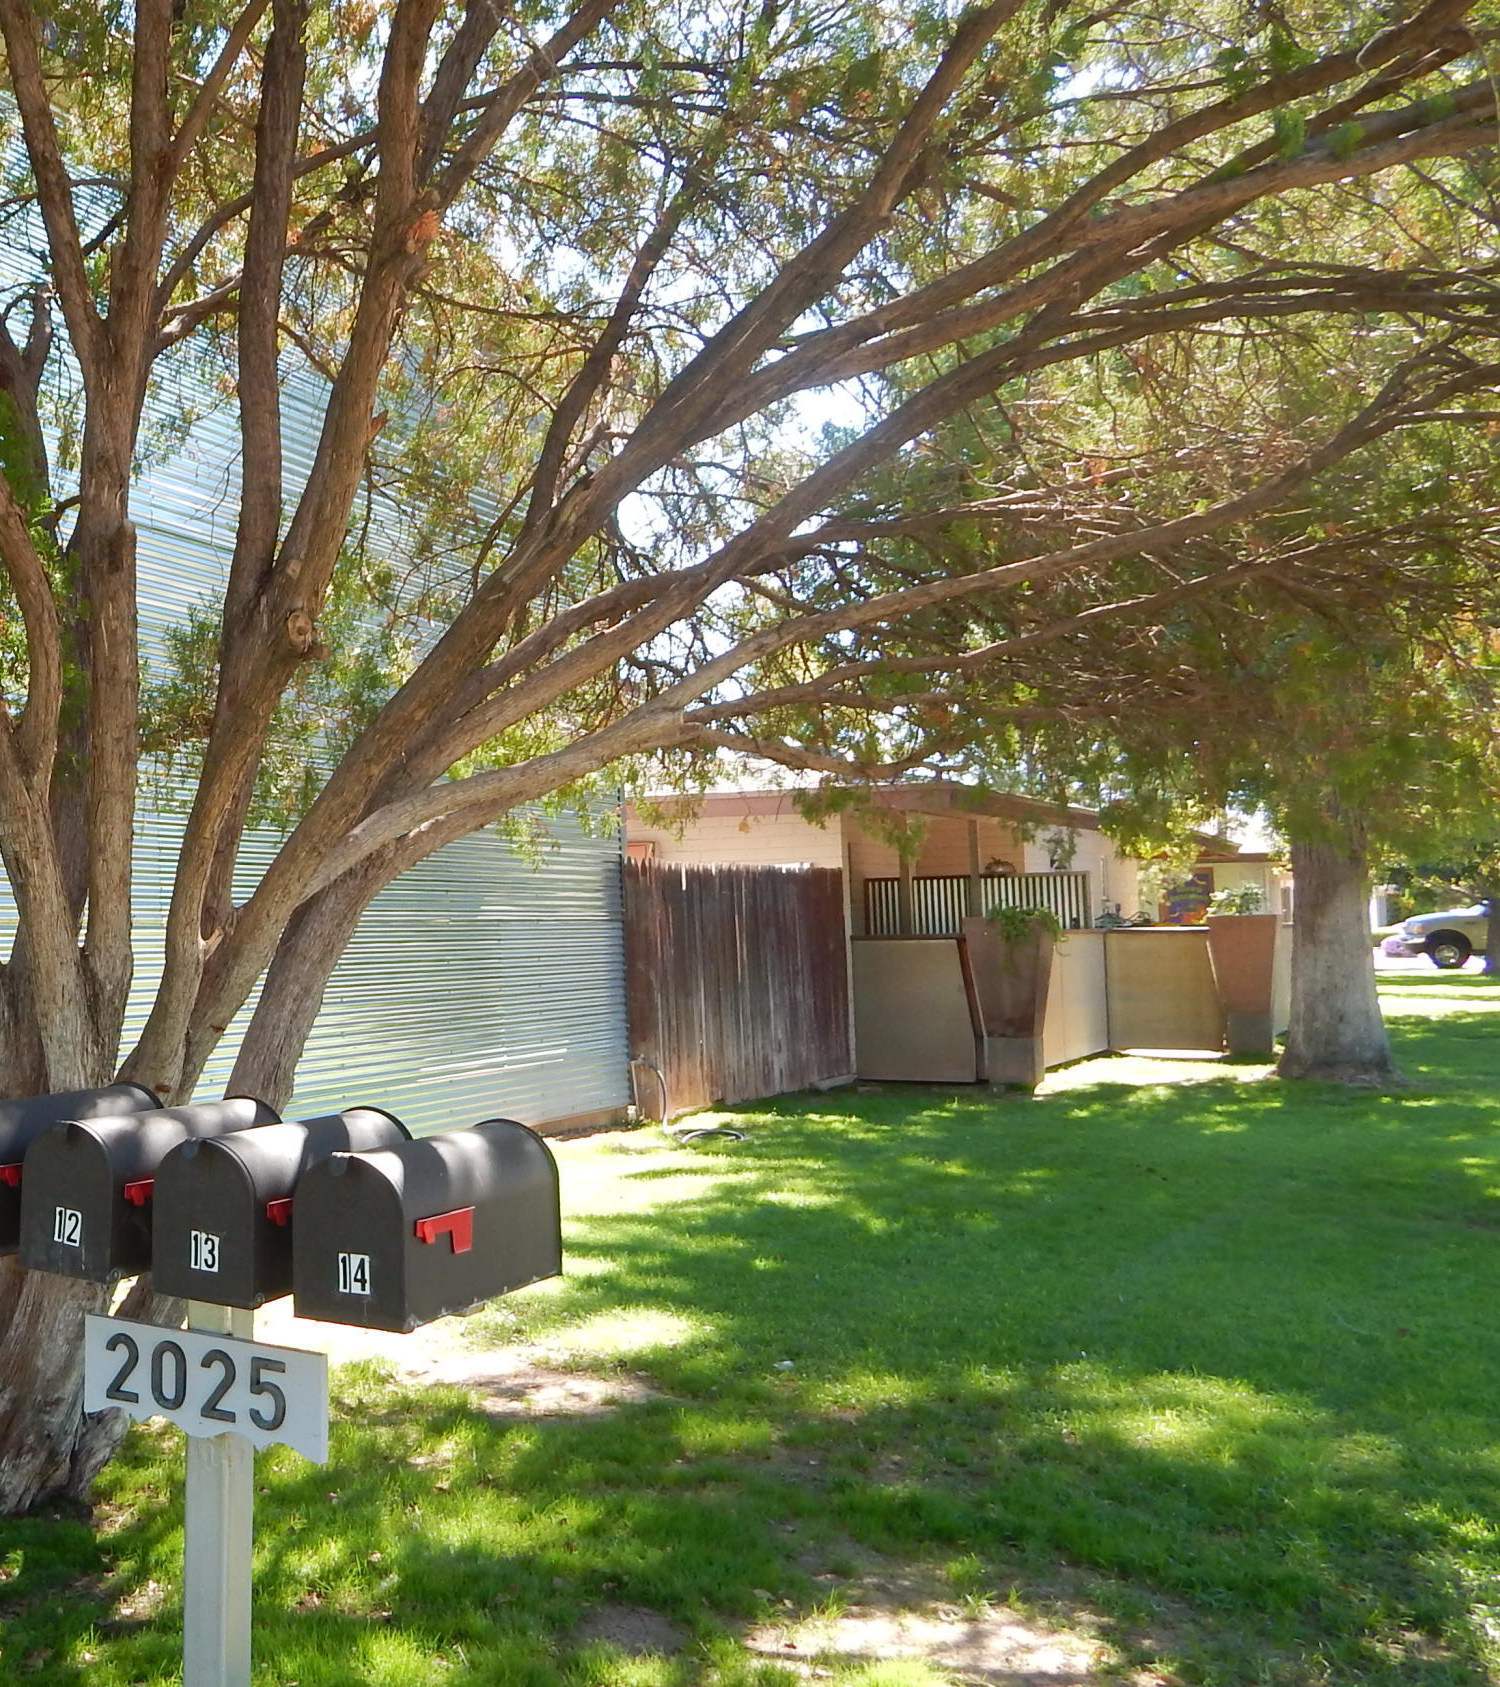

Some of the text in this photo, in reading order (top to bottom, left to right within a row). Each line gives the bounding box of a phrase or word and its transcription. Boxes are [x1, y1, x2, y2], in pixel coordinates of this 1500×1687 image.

[57, 1209, 80, 1244] 12
[193, 1233, 216, 1269] 13
[341, 1255, 368, 1292] 14
[104, 1332, 287, 1432] 2025
